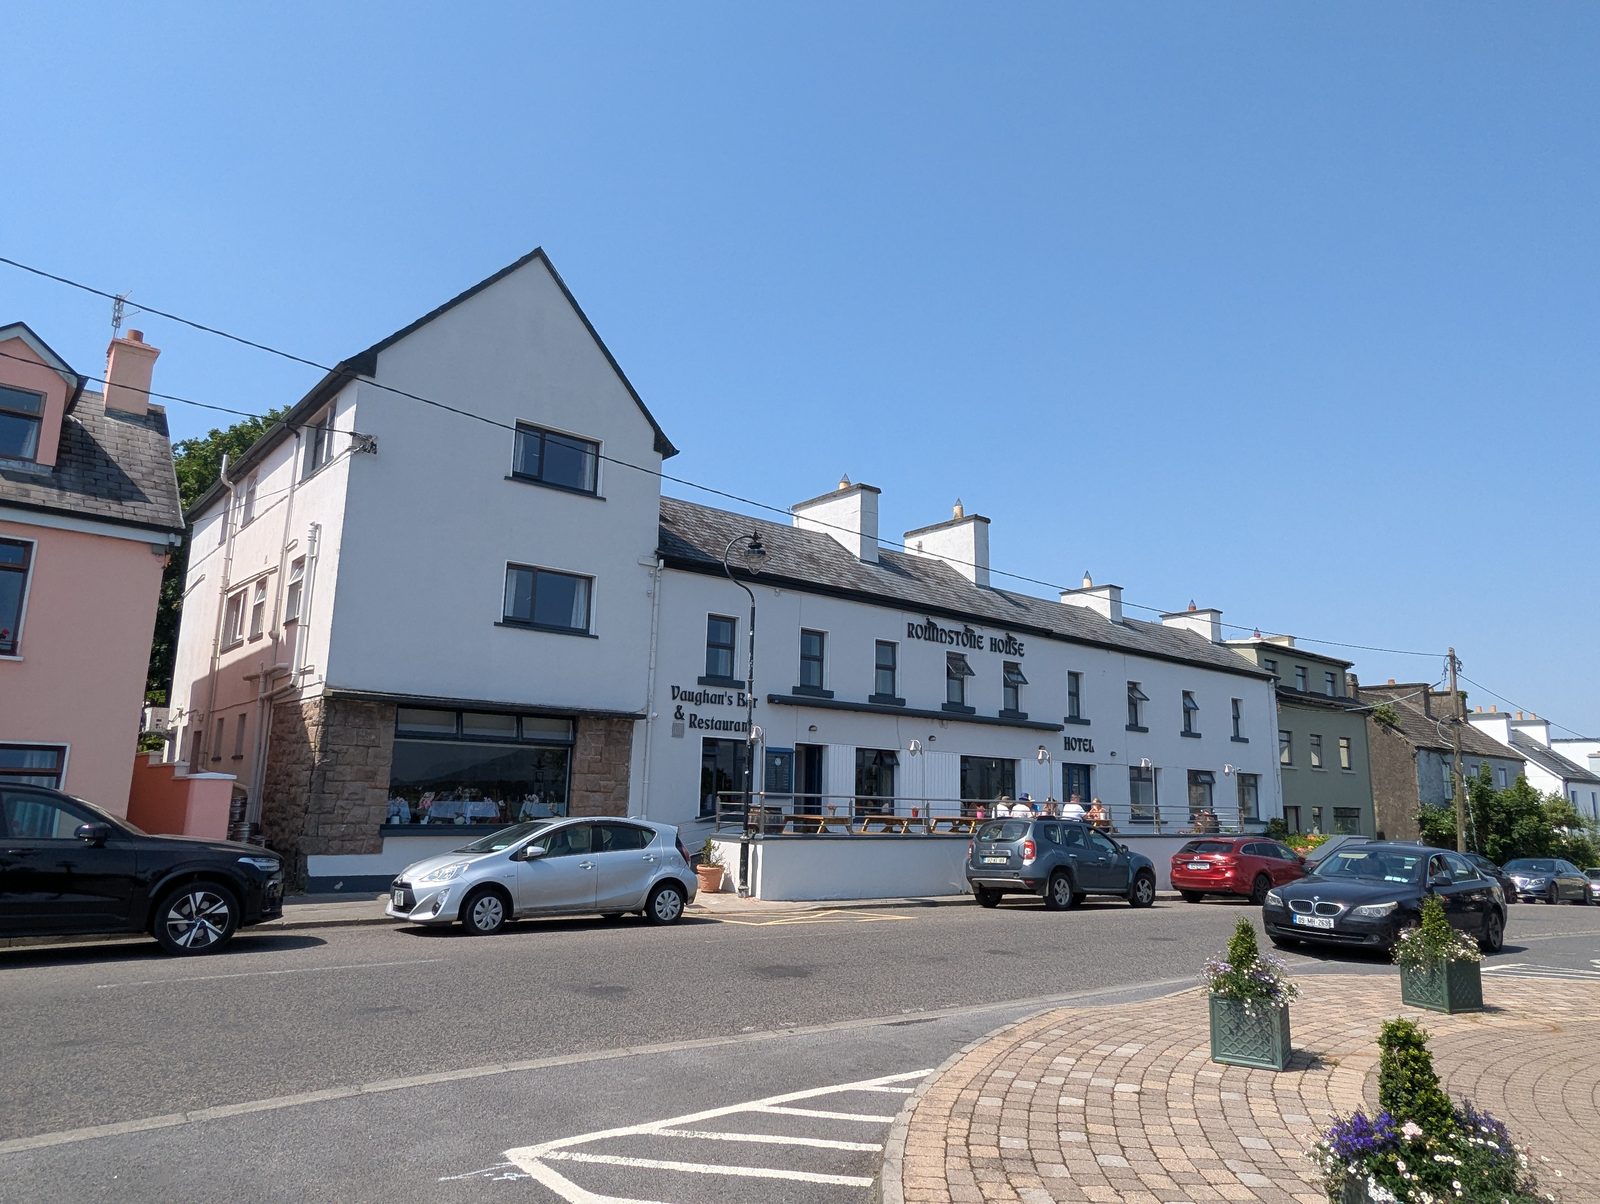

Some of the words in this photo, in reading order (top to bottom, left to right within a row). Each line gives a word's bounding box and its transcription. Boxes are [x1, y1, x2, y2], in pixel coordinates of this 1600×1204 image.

[907, 621, 985, 650] ROUNDSTONE
[990, 636, 1025, 657] HOUSE
[671, 685, 733, 706] Vaughan's
[737, 692, 758, 708] Br
[674, 704, 685, 721] &
[1064, 736, 1095, 753] HOTEL
